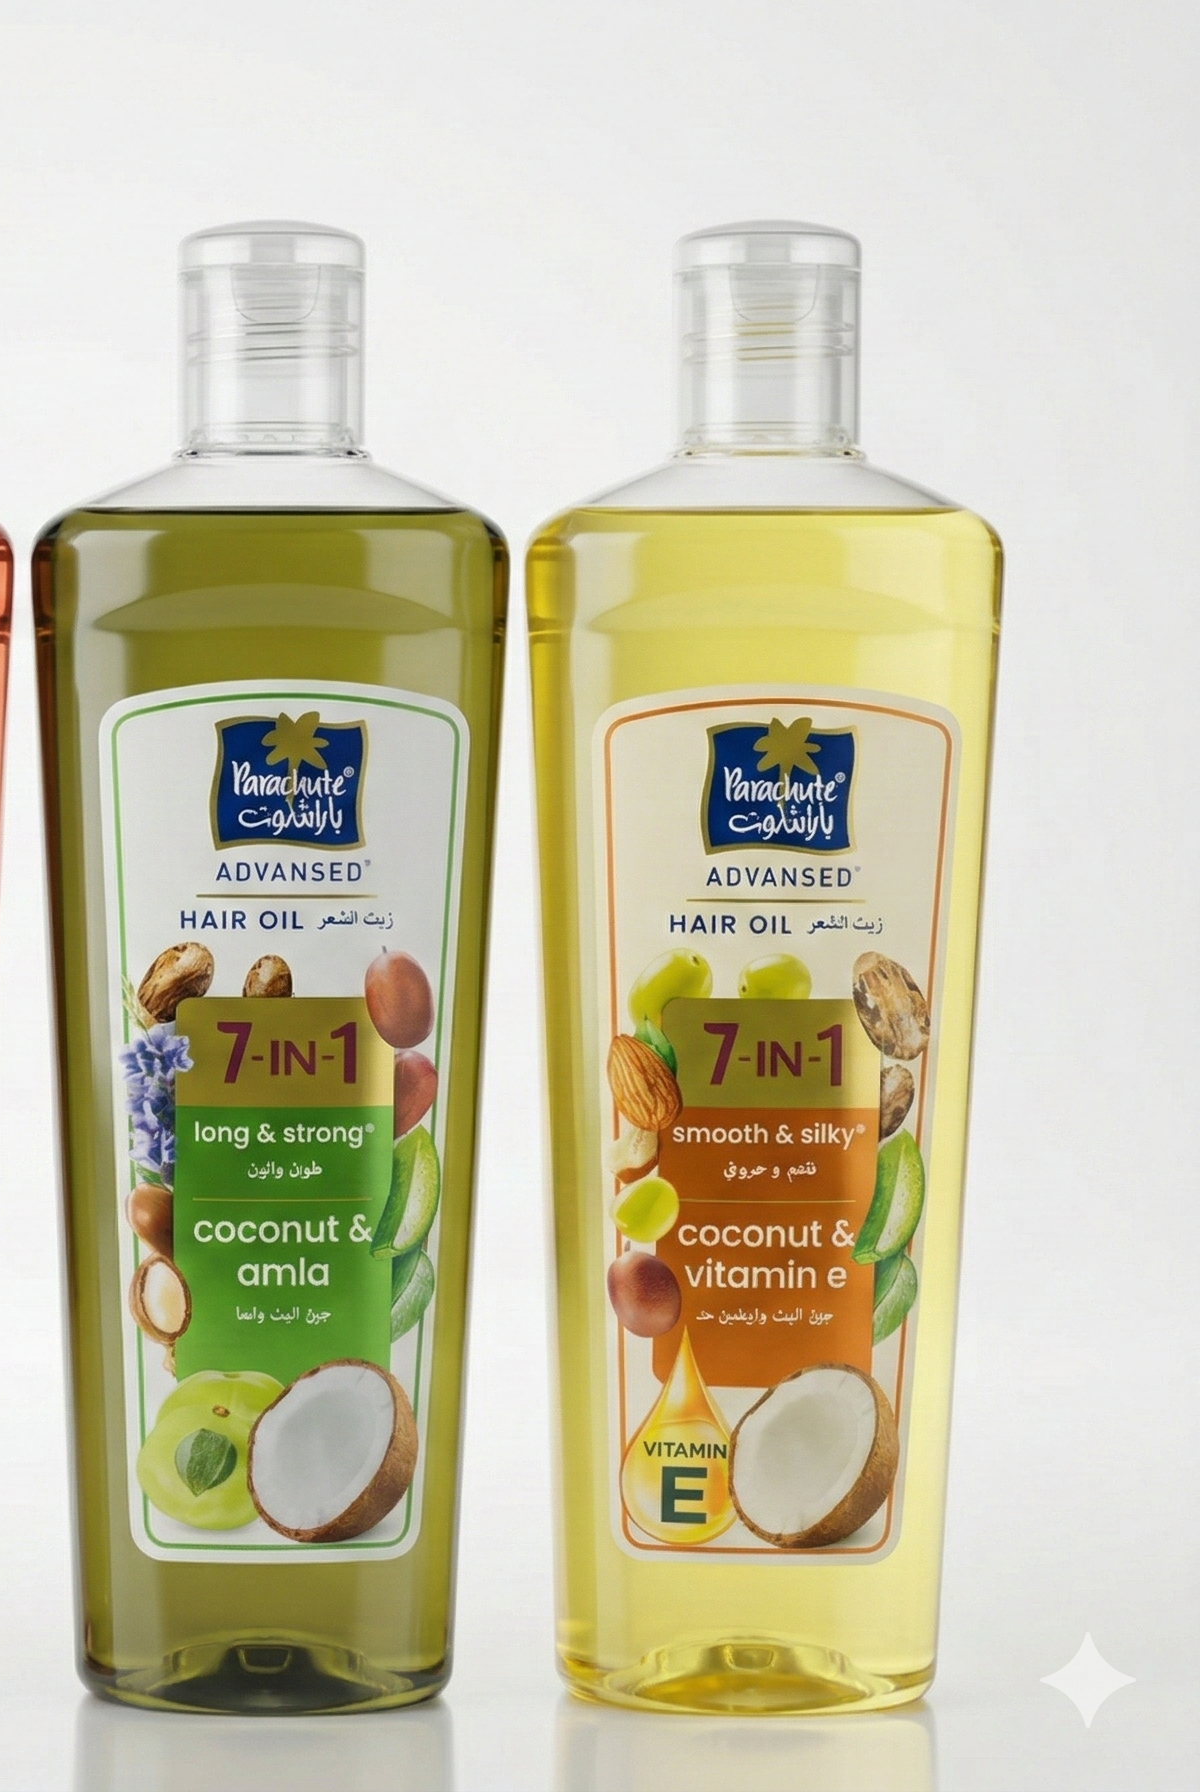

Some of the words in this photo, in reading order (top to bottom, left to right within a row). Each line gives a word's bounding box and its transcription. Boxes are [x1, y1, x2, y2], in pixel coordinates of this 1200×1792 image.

[181, 911, 246, 929] HAIR
[259, 911, 304, 929] OIL
[363, 912, 393, 929] زيت
[670, 915, 736, 934] HAIR
[749, 915, 792, 934] OIL
[853, 917, 883, 934] زيت
[217, 1022, 357, 1083] 7-IN-1
[704, 1023, 842, 1086] 7-IN-1
[195, 1122, 249, 1149] long
[257, 1123, 276, 1143] &
[672, 1124, 768, 1144] smooth
[776, 1124, 794, 1144] &
[193, 1215, 339, 1243] coconut
[349, 1214, 372, 1242] &
[678, 1220, 822, 1247] coconut
[831, 1220, 855, 1247] &
[238, 1258, 329, 1286] amla
[685, 1259, 816, 1289] vitamin
[827, 1266, 847, 1289] e
[644, 1441, 727, 1459] VITAMIN
[661, 1466, 707, 1523] E
